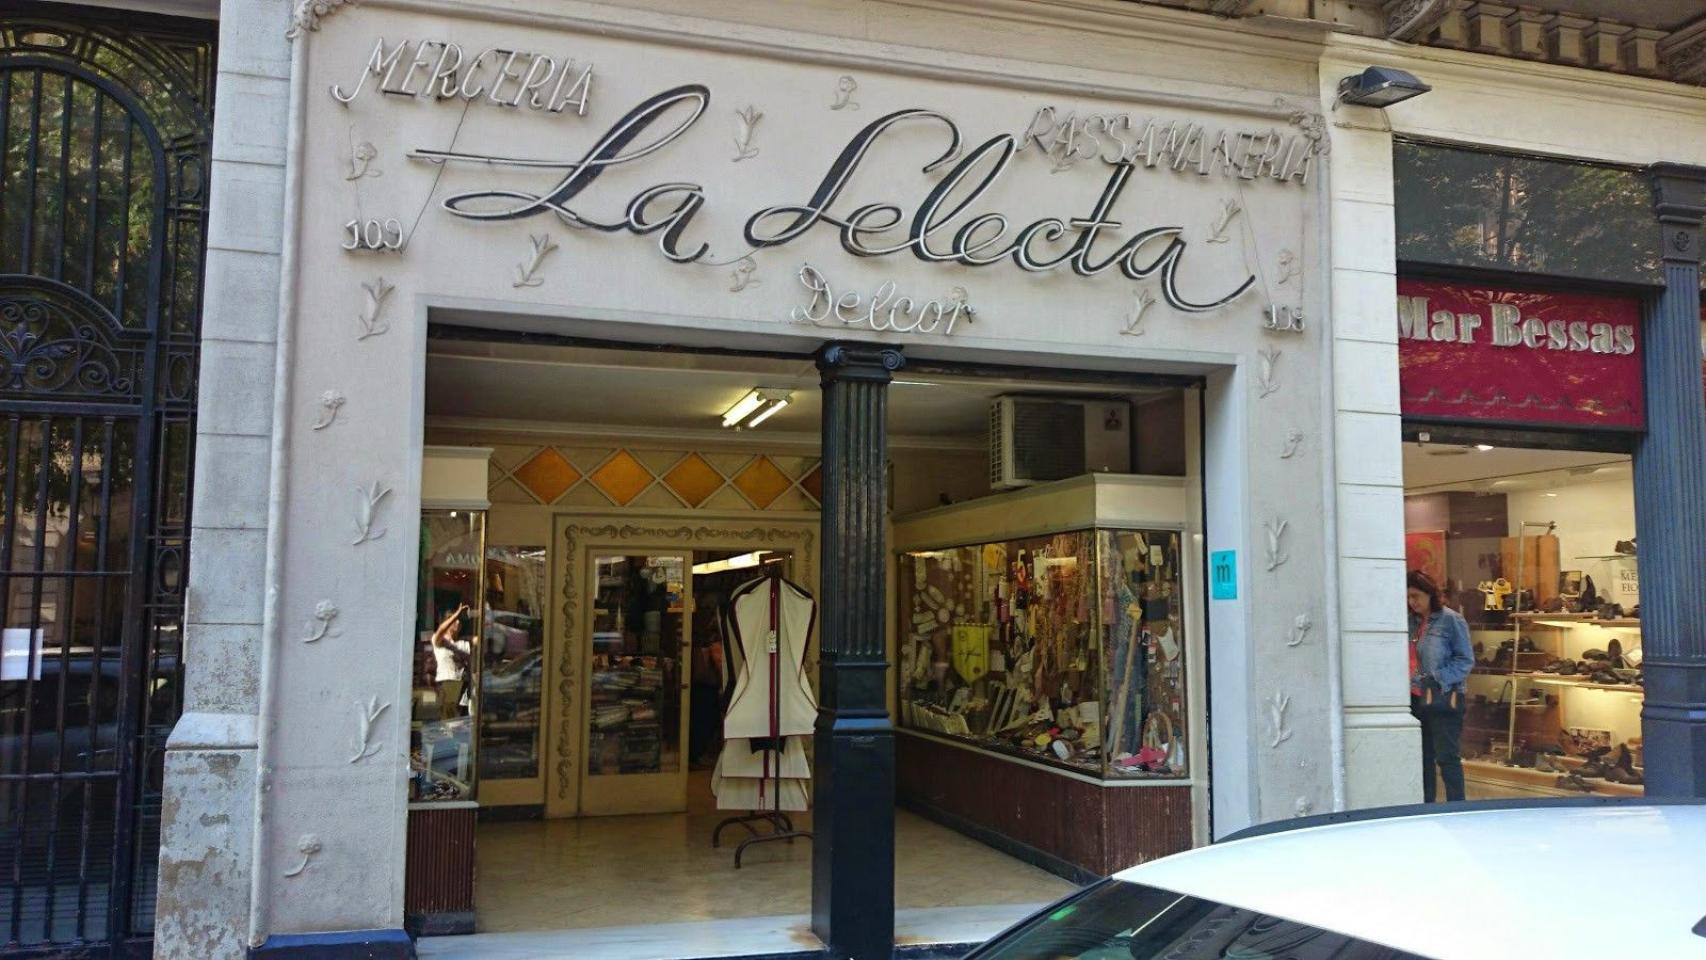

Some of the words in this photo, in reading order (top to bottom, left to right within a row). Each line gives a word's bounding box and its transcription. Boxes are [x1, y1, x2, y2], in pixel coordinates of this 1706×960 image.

[332, 36, 595, 117] MERCERIA
[407, 83, 711, 263] La
[341, 217, 403, 250] 109
[790, 265, 977, 336] Delcor
[1397, 294, 1482, 345] Mar
[1490, 302, 1635, 355] Bessas
